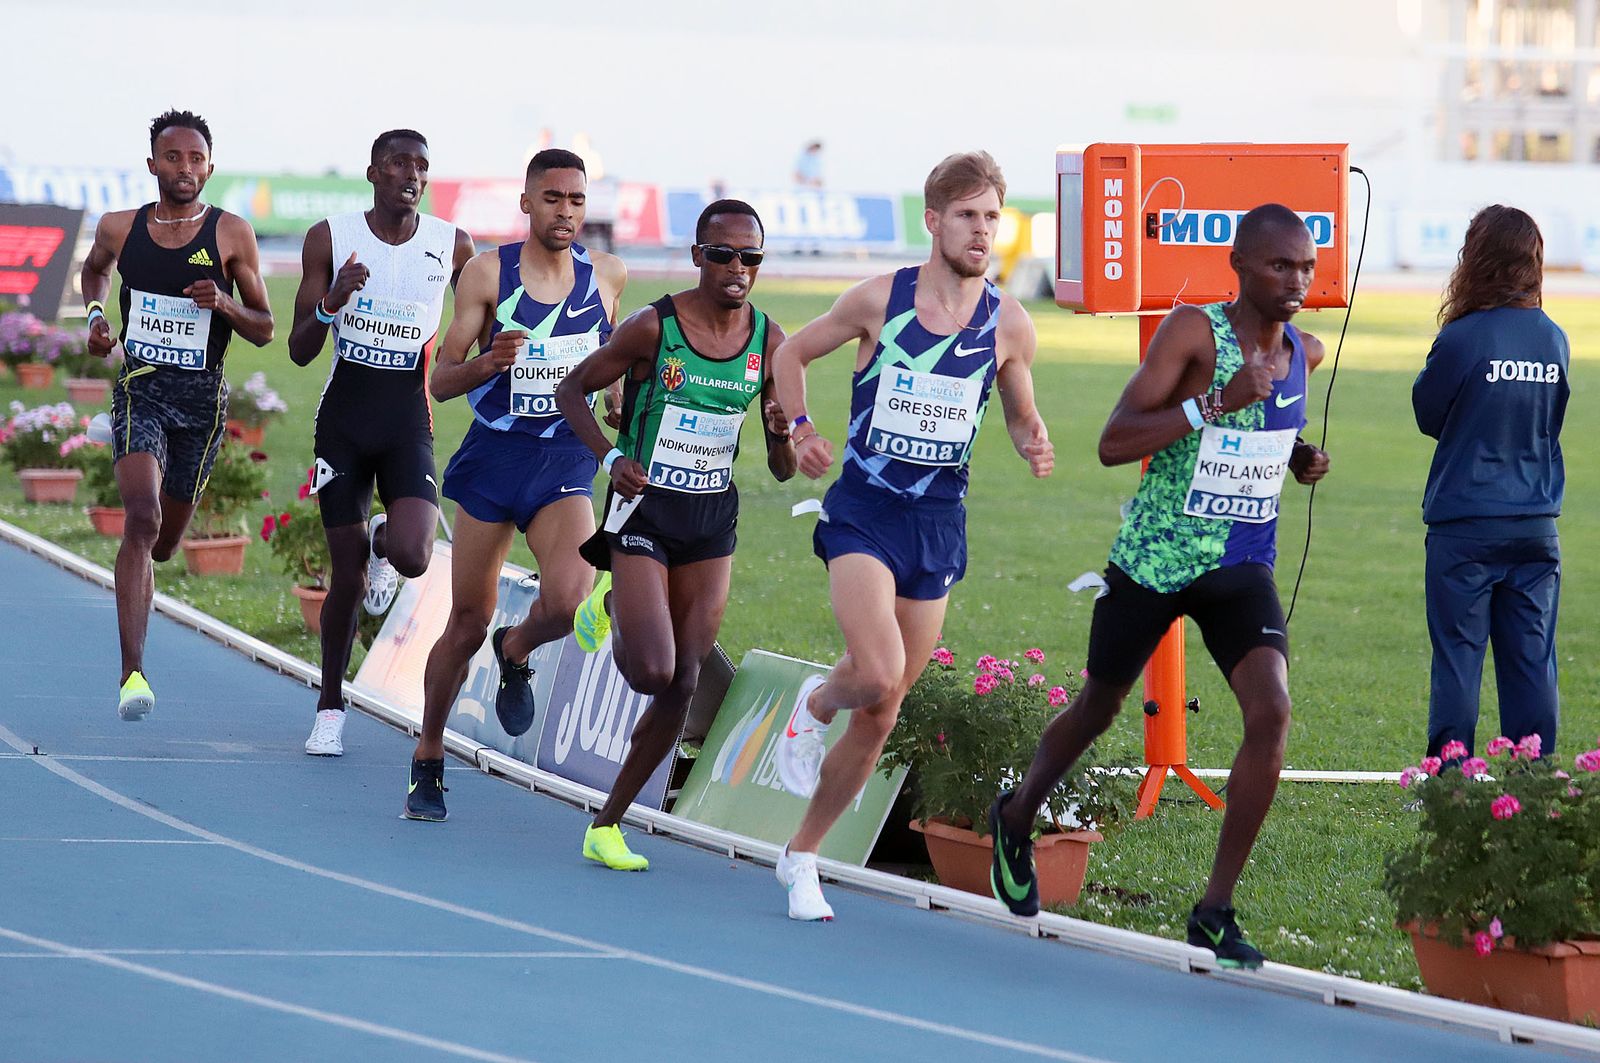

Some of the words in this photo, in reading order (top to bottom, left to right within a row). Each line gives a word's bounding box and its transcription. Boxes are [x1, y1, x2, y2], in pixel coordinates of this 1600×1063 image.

[1104, 178, 1123, 281] MONDO
[1162, 213, 1332, 245] MOO
[188, 257, 213, 267] adidas
[170, 307, 200, 316] HUELVA
[386, 308, 416, 318] HUELVA
[140, 316, 195, 336] HABTE
[343, 313, 421, 340] MOHUMED
[160, 337, 172, 346] 49
[373, 337, 385, 348] 51
[560, 344, 589, 354] HUELVA
[131, 343, 196, 365] Joma
[342, 341, 407, 366] Joma
[1485, 360, 1560, 384] Joma
[688, 374, 744, 392] VILLARREAL
[930, 386, 964, 398] HUELVA
[888, 397, 968, 421] GRESSIER
[919, 420, 937, 433] 93
[658, 437, 735, 457] NDIKUMWENAYO
[874, 432, 954, 461] Joma
[694, 459, 708, 470] 52
[655, 466, 723, 489] Joma
[1238, 484, 1254, 495] 48
